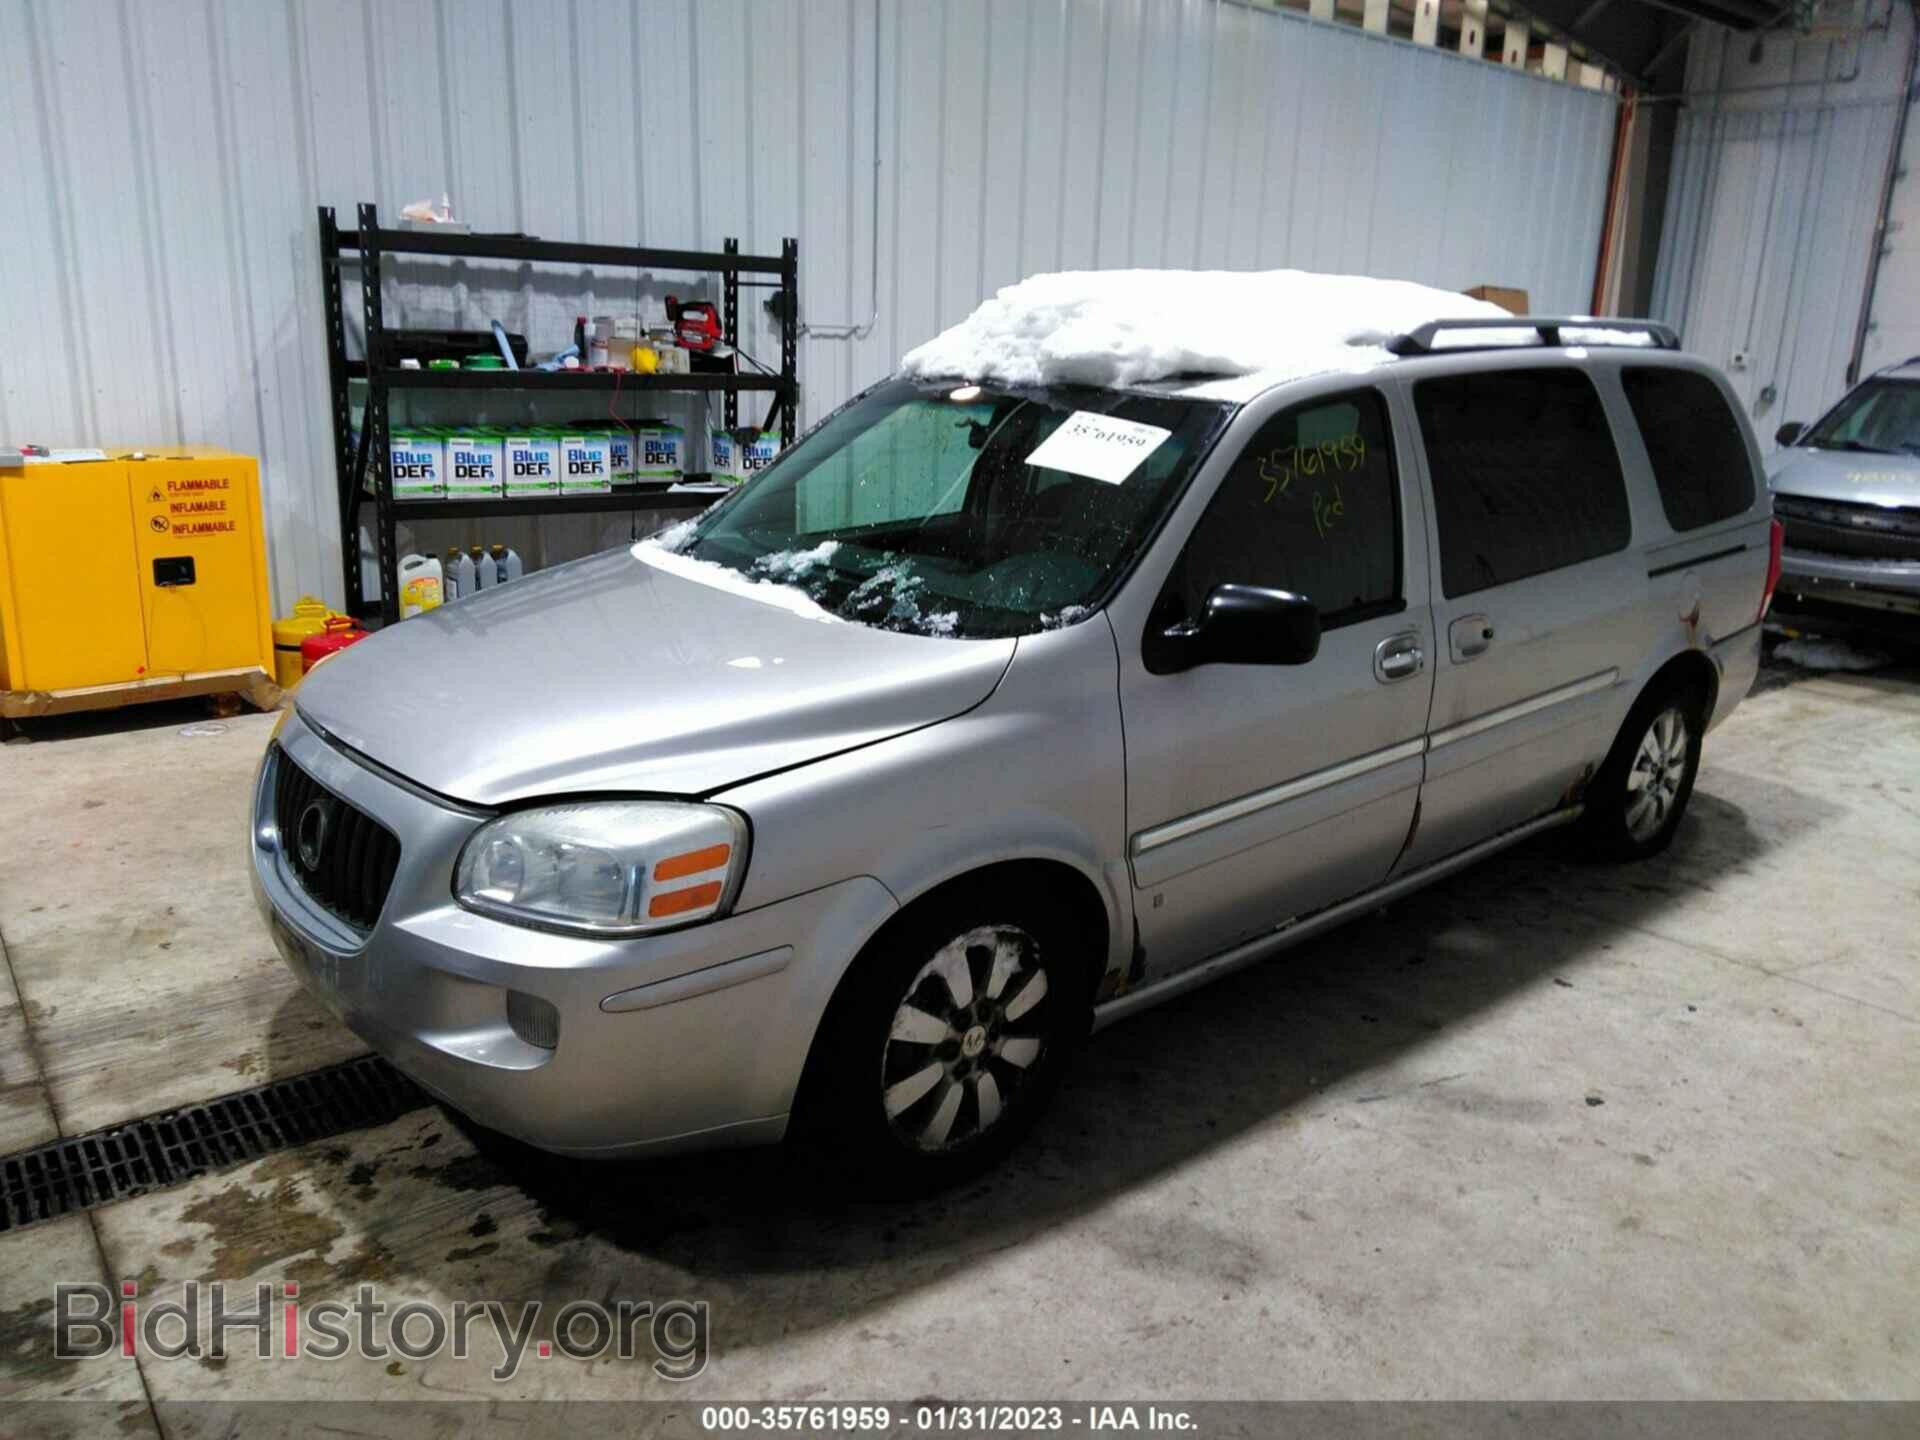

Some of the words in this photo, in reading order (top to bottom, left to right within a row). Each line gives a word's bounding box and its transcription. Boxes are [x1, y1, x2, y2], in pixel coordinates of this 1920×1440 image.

[645, 440, 676, 452] Blue
[743, 446, 773, 457] Blue
[393, 451, 433, 464] Blue
[455, 451, 492, 464] Blue
[513, 450, 550, 461] Blue
[568, 449, 602, 461] Blue
[611, 454, 627, 467] EF
[645, 452, 675, 464] DEF
[514, 463, 551, 475] DEF
[568, 461, 602, 474] DEF
[743, 458, 773, 469] DEF
[393, 465, 433, 478] DEF
[455, 465, 492, 478] DEF
[167, 478, 230, 491] FLAMMABLE
[170, 500, 226, 513] INFLAMABLE
[172, 520, 235, 534] INFLAMMABLE
